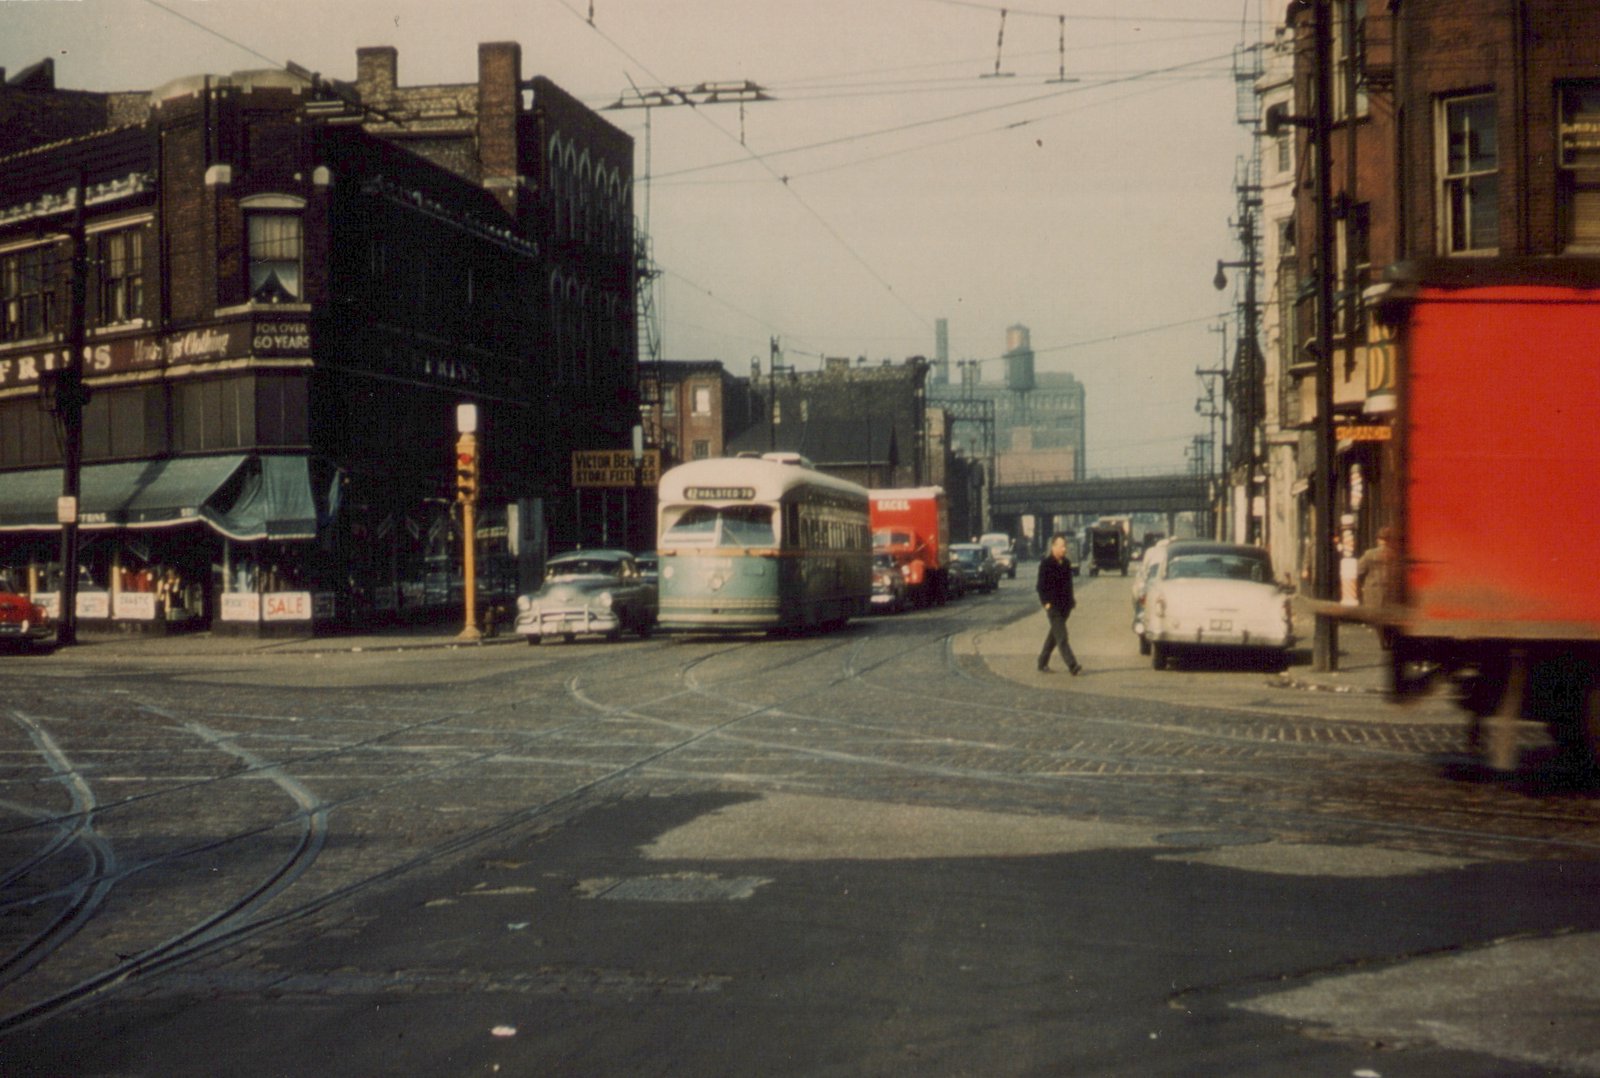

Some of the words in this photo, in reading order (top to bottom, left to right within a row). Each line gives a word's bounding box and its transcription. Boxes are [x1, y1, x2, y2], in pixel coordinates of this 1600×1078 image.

[253, 335, 273, 350] 60
[274, 335, 310, 350] YEARS
[610, 469, 656, 482] FIXTUES
[266, 596, 303, 615] SALE
